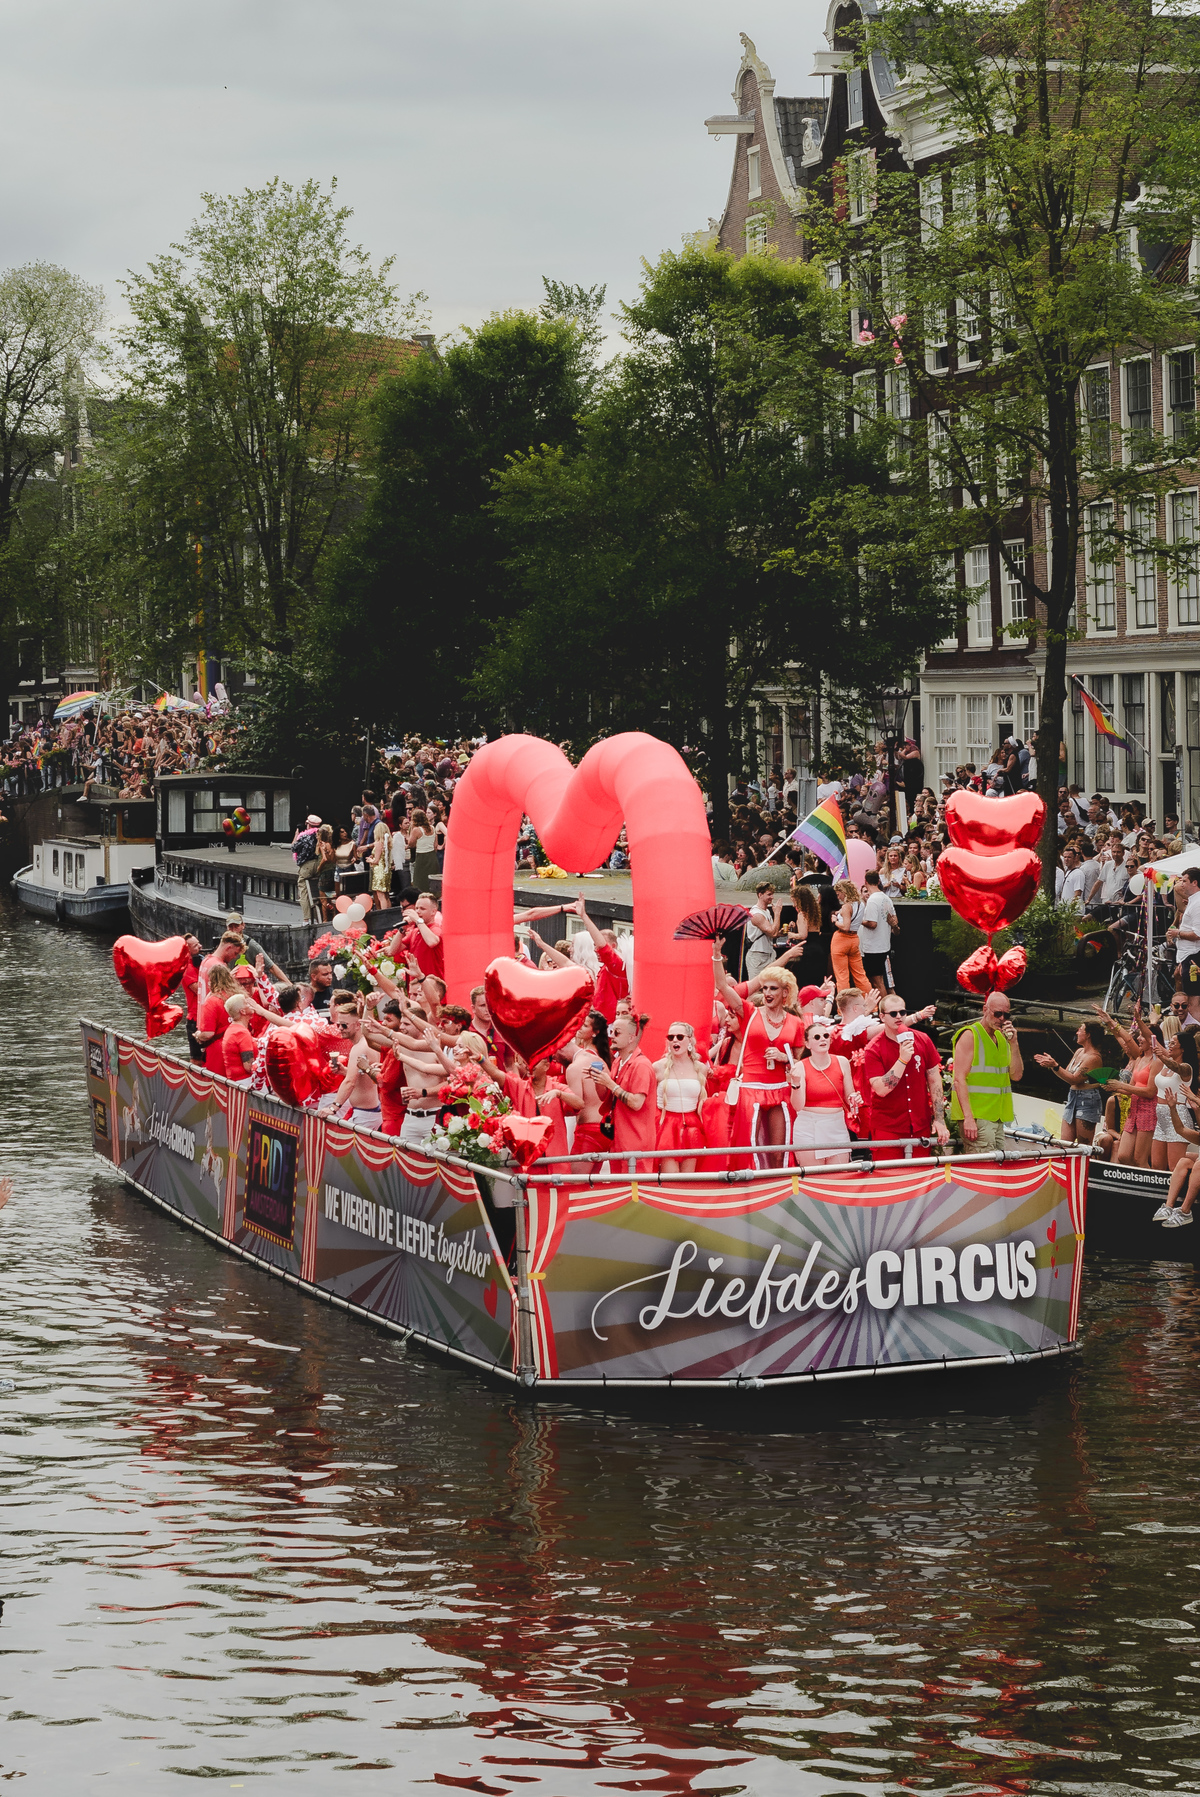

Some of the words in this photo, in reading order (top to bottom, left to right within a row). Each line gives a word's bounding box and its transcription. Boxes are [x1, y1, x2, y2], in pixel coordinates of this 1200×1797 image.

[252, 1131, 291, 1195] PRIDE
[250, 1190, 288, 1226] AMSTERDAM
[325, 1184, 339, 1223] WE
[341, 1190, 376, 1238] VIEREN
[378, 1205, 394, 1245] DE
[396, 1211, 435, 1262] LIEFDE
[437, 1222, 491, 1284] together
